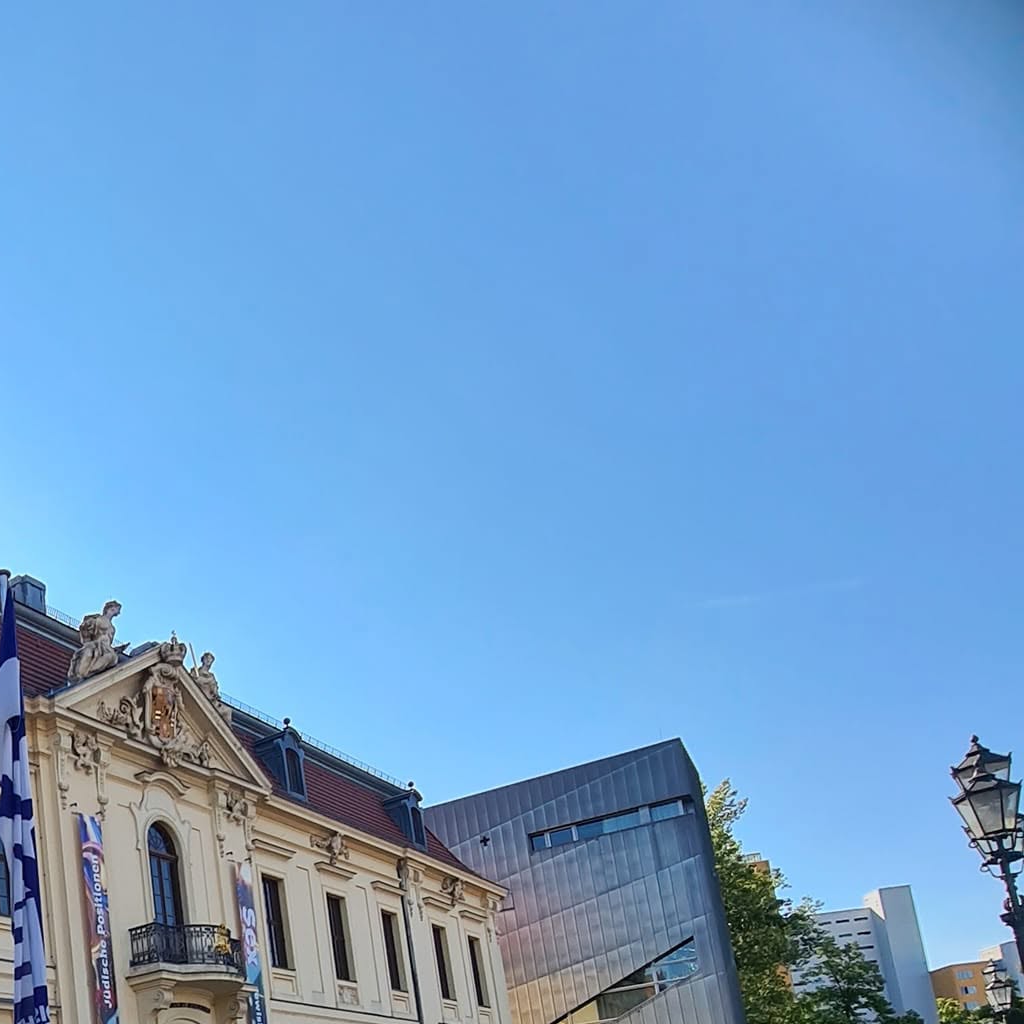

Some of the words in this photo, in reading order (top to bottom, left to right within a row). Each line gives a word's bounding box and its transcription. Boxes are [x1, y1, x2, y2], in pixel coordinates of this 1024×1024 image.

[90, 855, 108, 935] Positionen
[242, 906, 258, 966] Sex
[98, 940, 112, 1008] Jüdische
